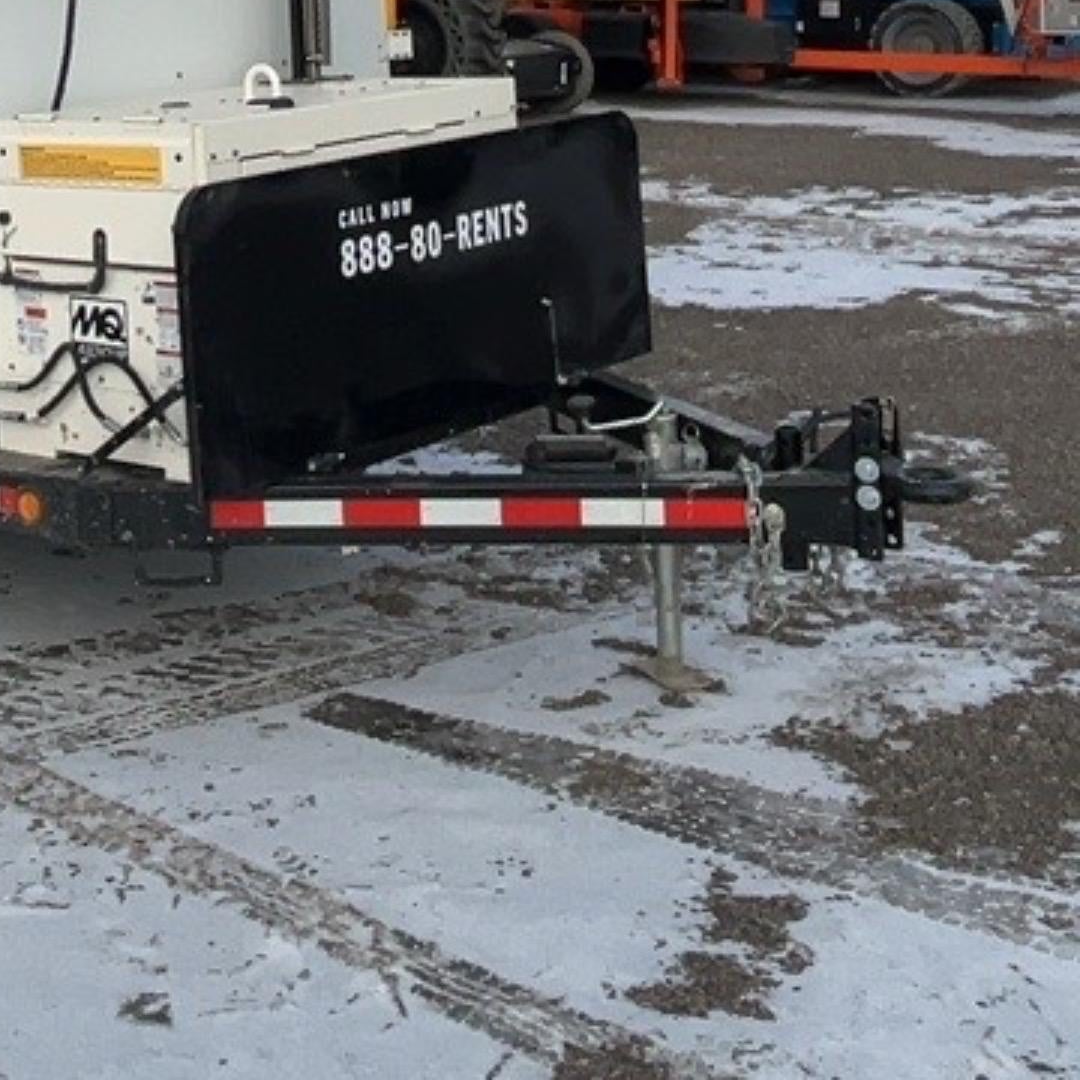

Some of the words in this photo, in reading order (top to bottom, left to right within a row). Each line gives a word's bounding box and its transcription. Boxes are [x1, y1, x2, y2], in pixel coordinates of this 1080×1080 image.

[338, 204, 375, 229] CALL
[380, 197, 412, 220] NOW
[340, 200, 528, 278] 888-80-RENTS
[72, 304, 127, 343] MQ
